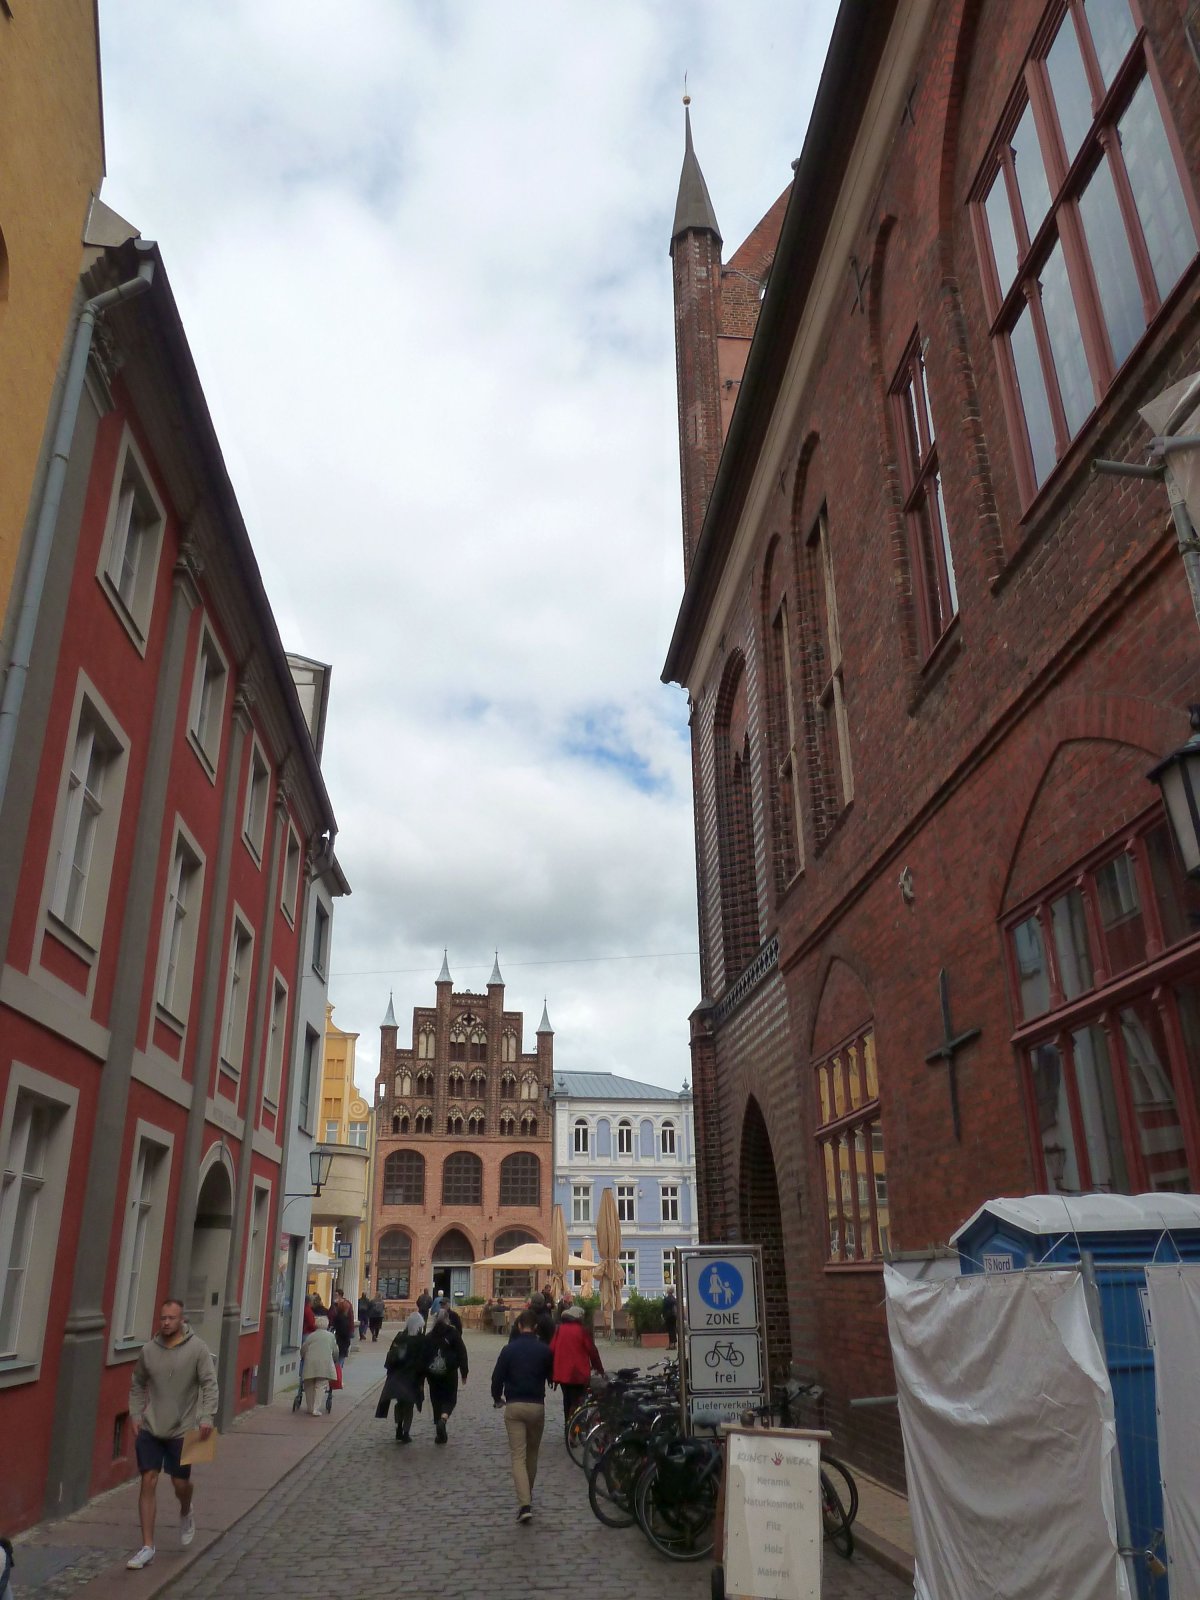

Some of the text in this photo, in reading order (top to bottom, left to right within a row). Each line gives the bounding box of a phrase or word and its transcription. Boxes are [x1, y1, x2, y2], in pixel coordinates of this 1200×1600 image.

[993, 1258, 1011, 1271] Nord
[705, 1312, 740, 1325] ZONE
[715, 1371, 737, 1383] frei
[696, 1400, 757, 1411] Lieferverkehr
[737, 1452, 813, 1466] KUNST WERK
[757, 1475, 791, 1487] Keramik
[743, 1497, 804, 1510] Naturkosmetik
[766, 1521, 781, 1531] Filz
[764, 1543, 783, 1554] Holz
[757, 1567, 791, 1578] Malerei
